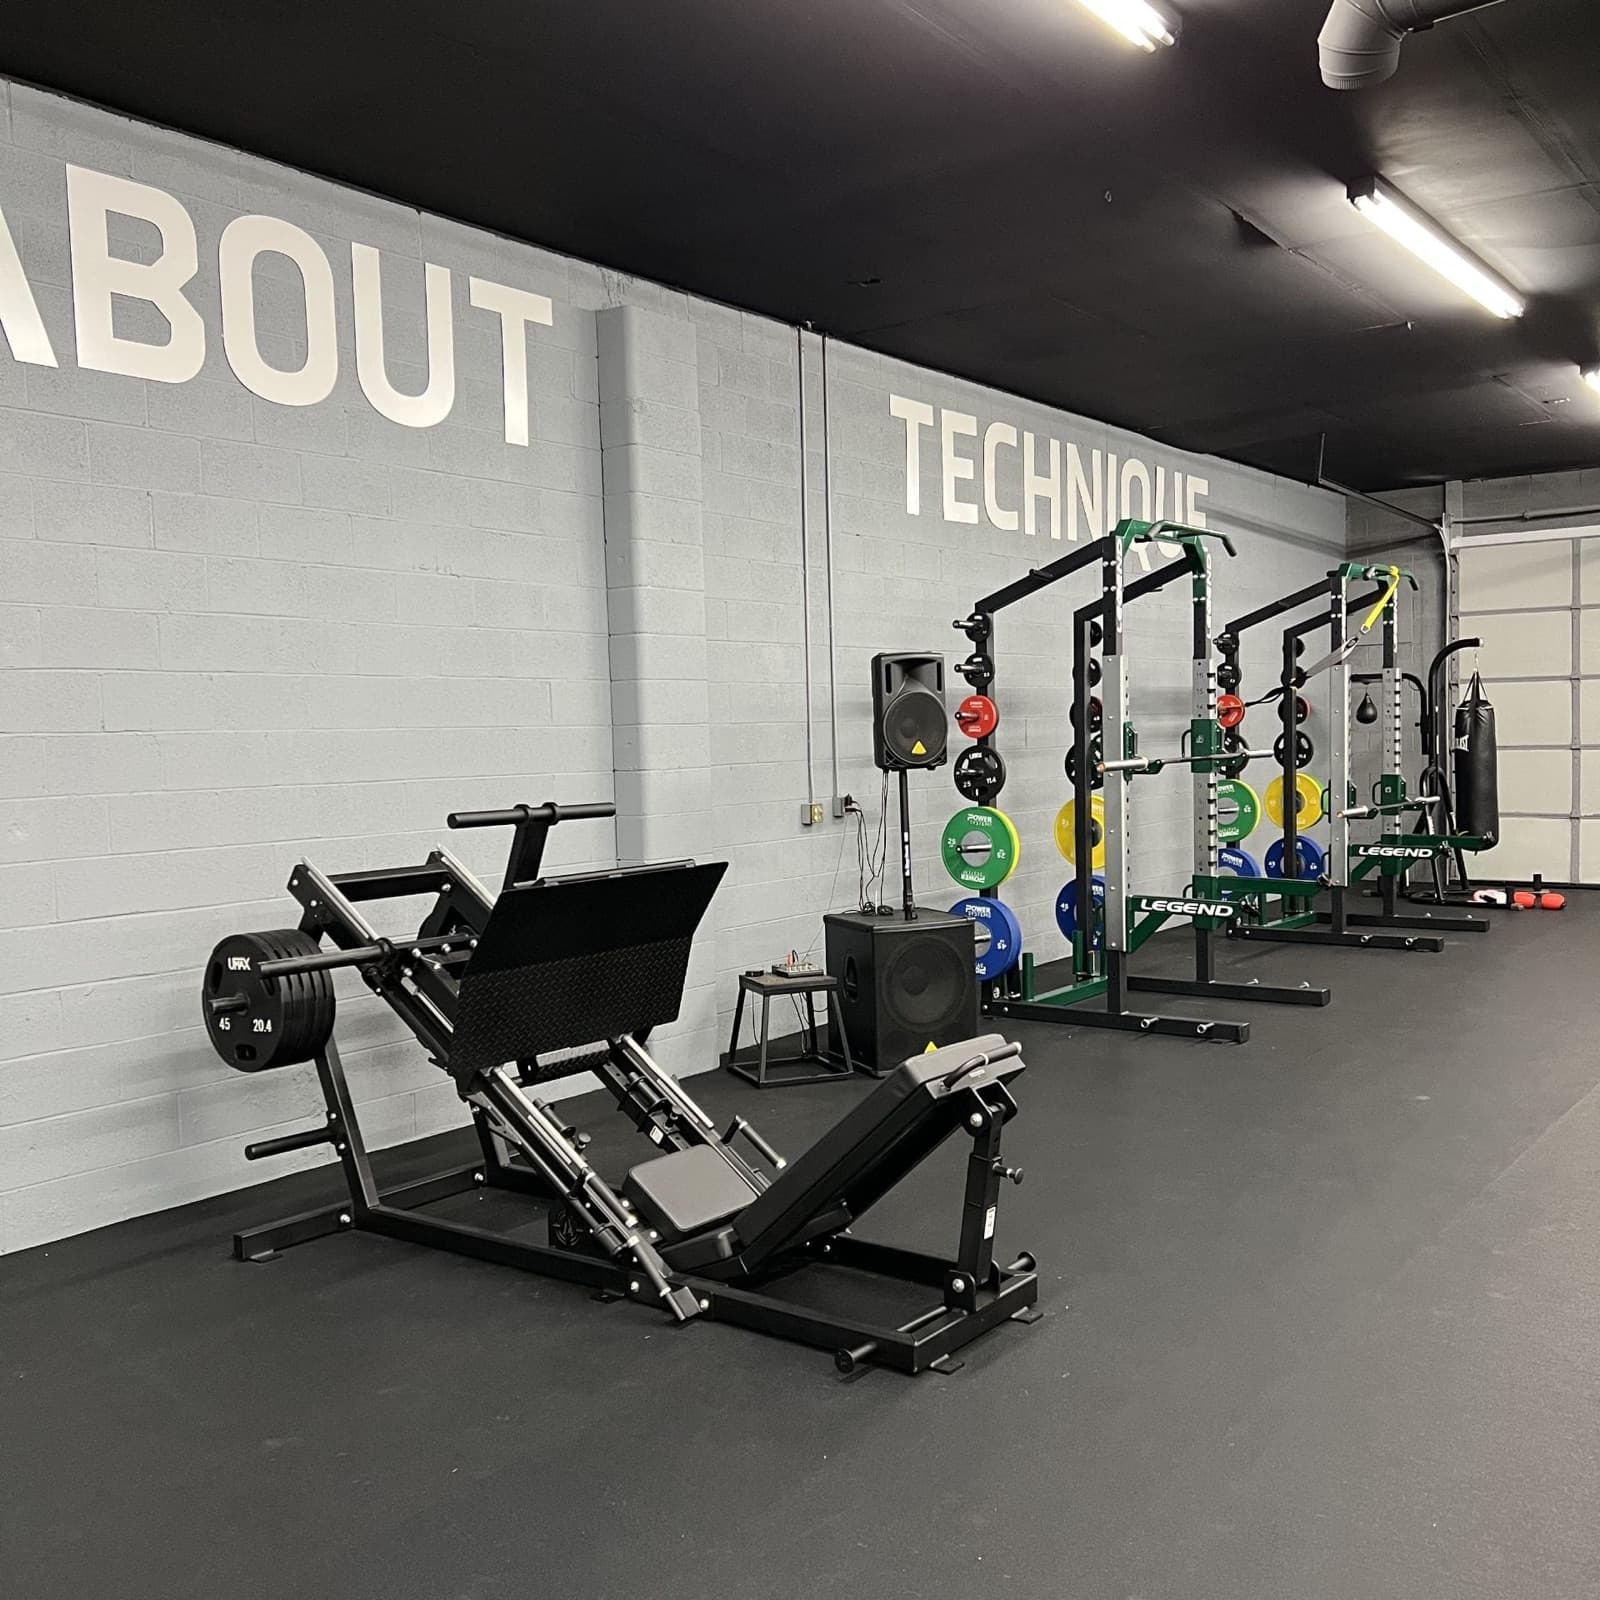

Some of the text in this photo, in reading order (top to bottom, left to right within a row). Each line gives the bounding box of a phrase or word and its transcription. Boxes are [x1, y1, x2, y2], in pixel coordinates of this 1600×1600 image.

[889, 393, 1209, 572] TECHNIQUE
[967, 813, 992, 823] POWER
[1359, 846, 1433, 858] LEGEND
[965, 904, 991, 913] POWER
[1140, 898, 1234, 917] LEGEND
[219, 1017, 272, 1033] 45 20.4
